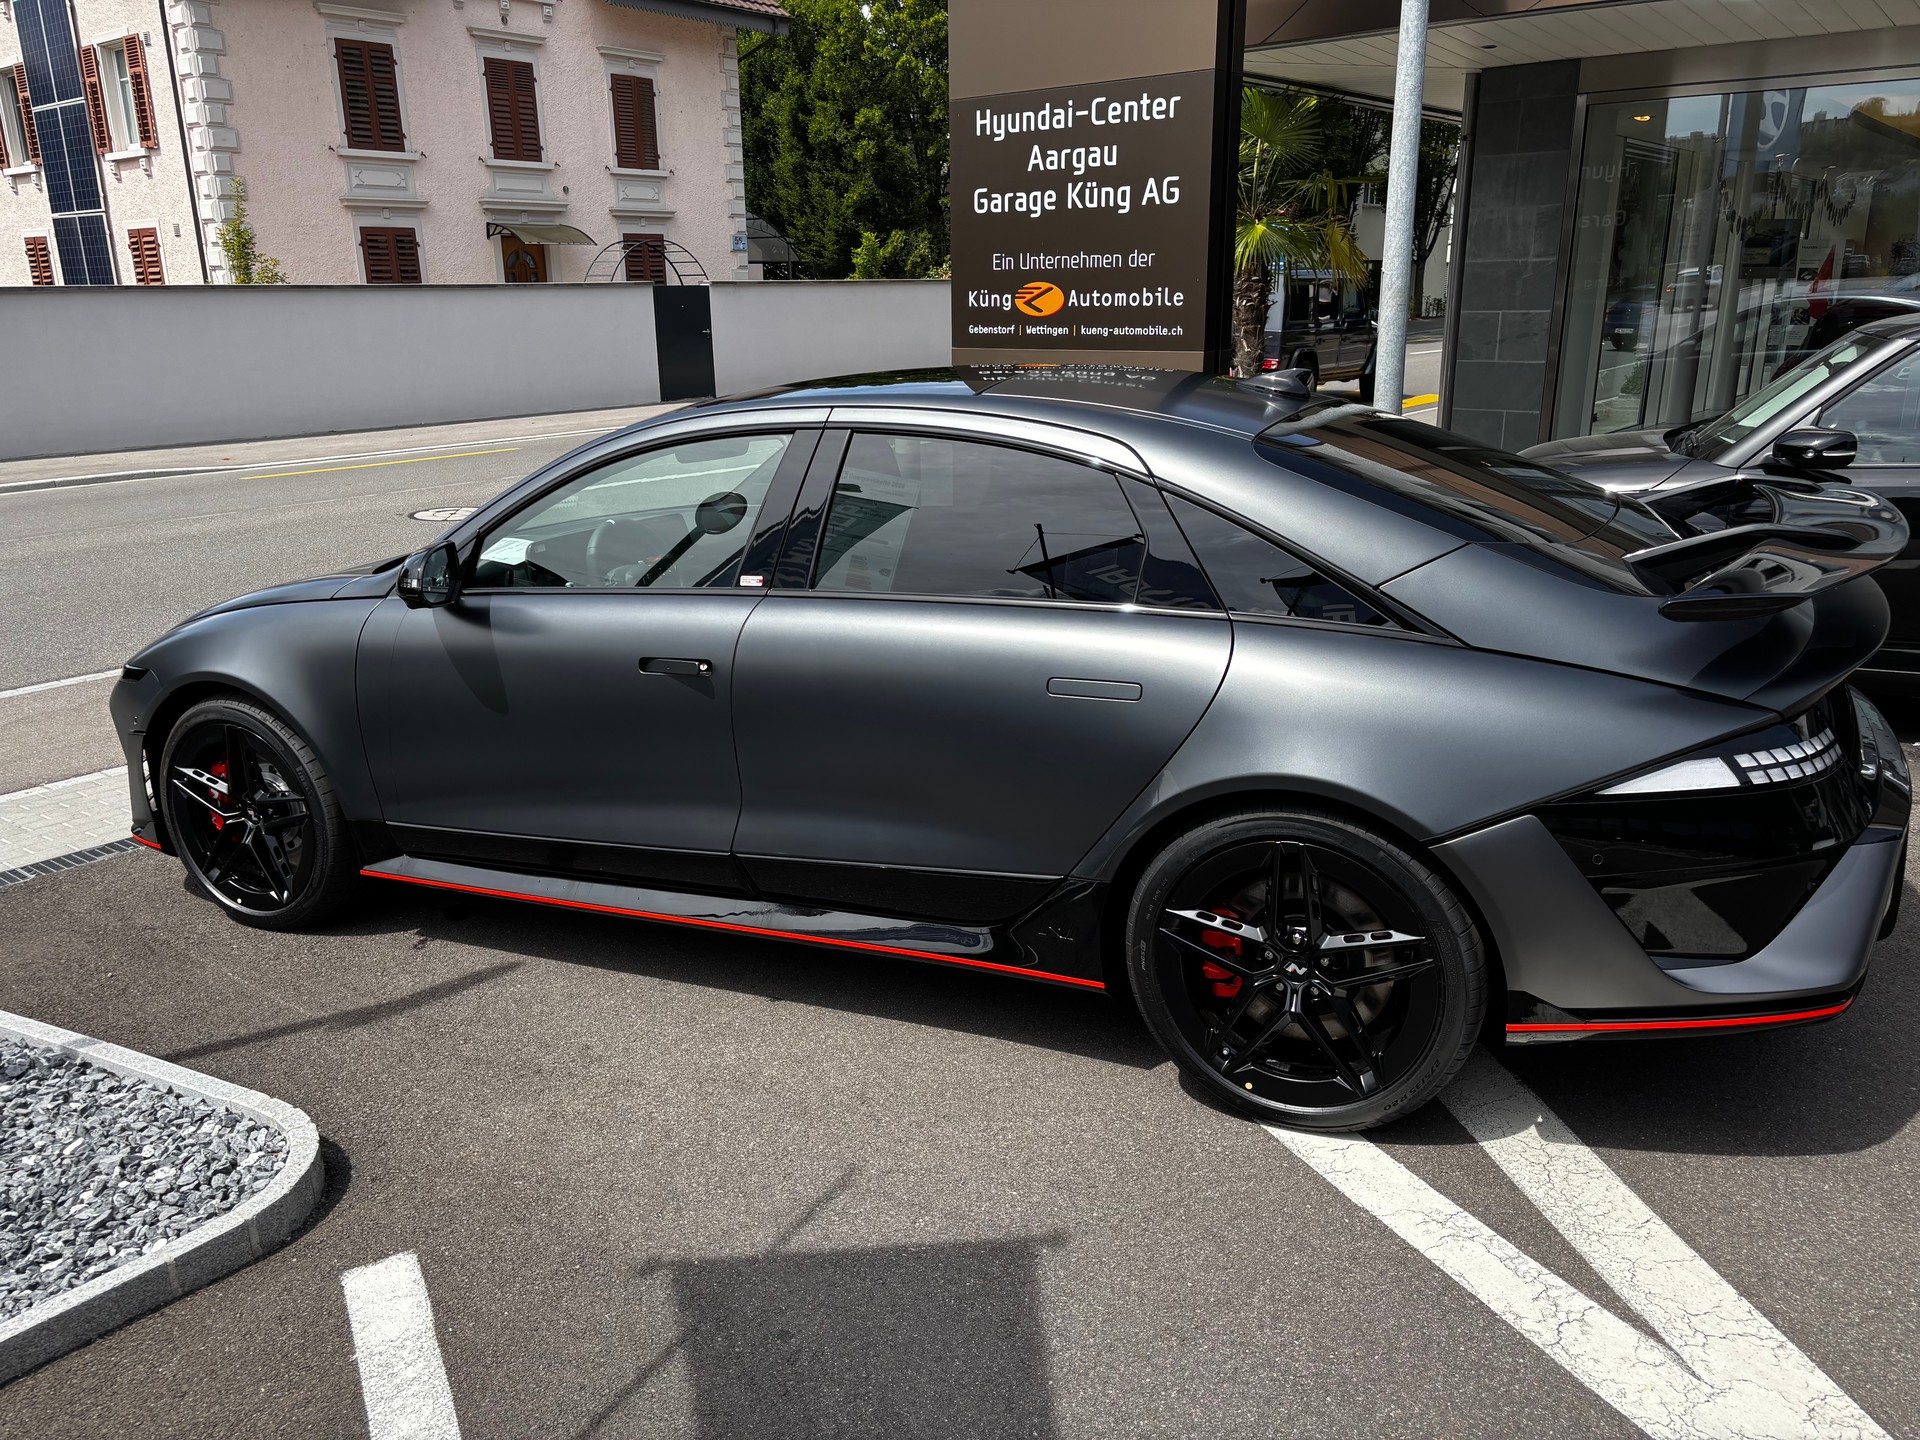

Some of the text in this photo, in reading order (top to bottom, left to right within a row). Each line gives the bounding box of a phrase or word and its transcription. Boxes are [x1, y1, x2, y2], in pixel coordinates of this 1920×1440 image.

[975, 92, 1182, 142] Hyundai-Center
[1027, 144, 1118, 176] Aargau
[973, 175, 1180, 218] Garage Küng AG
[992, 249, 1156, 271] Ein Unternehmen der
[968, 286, 1184, 311] Küng Automobile
[968, 324, 1183, 337] Gebenstorf Wettingen kueng-automobile.ch
